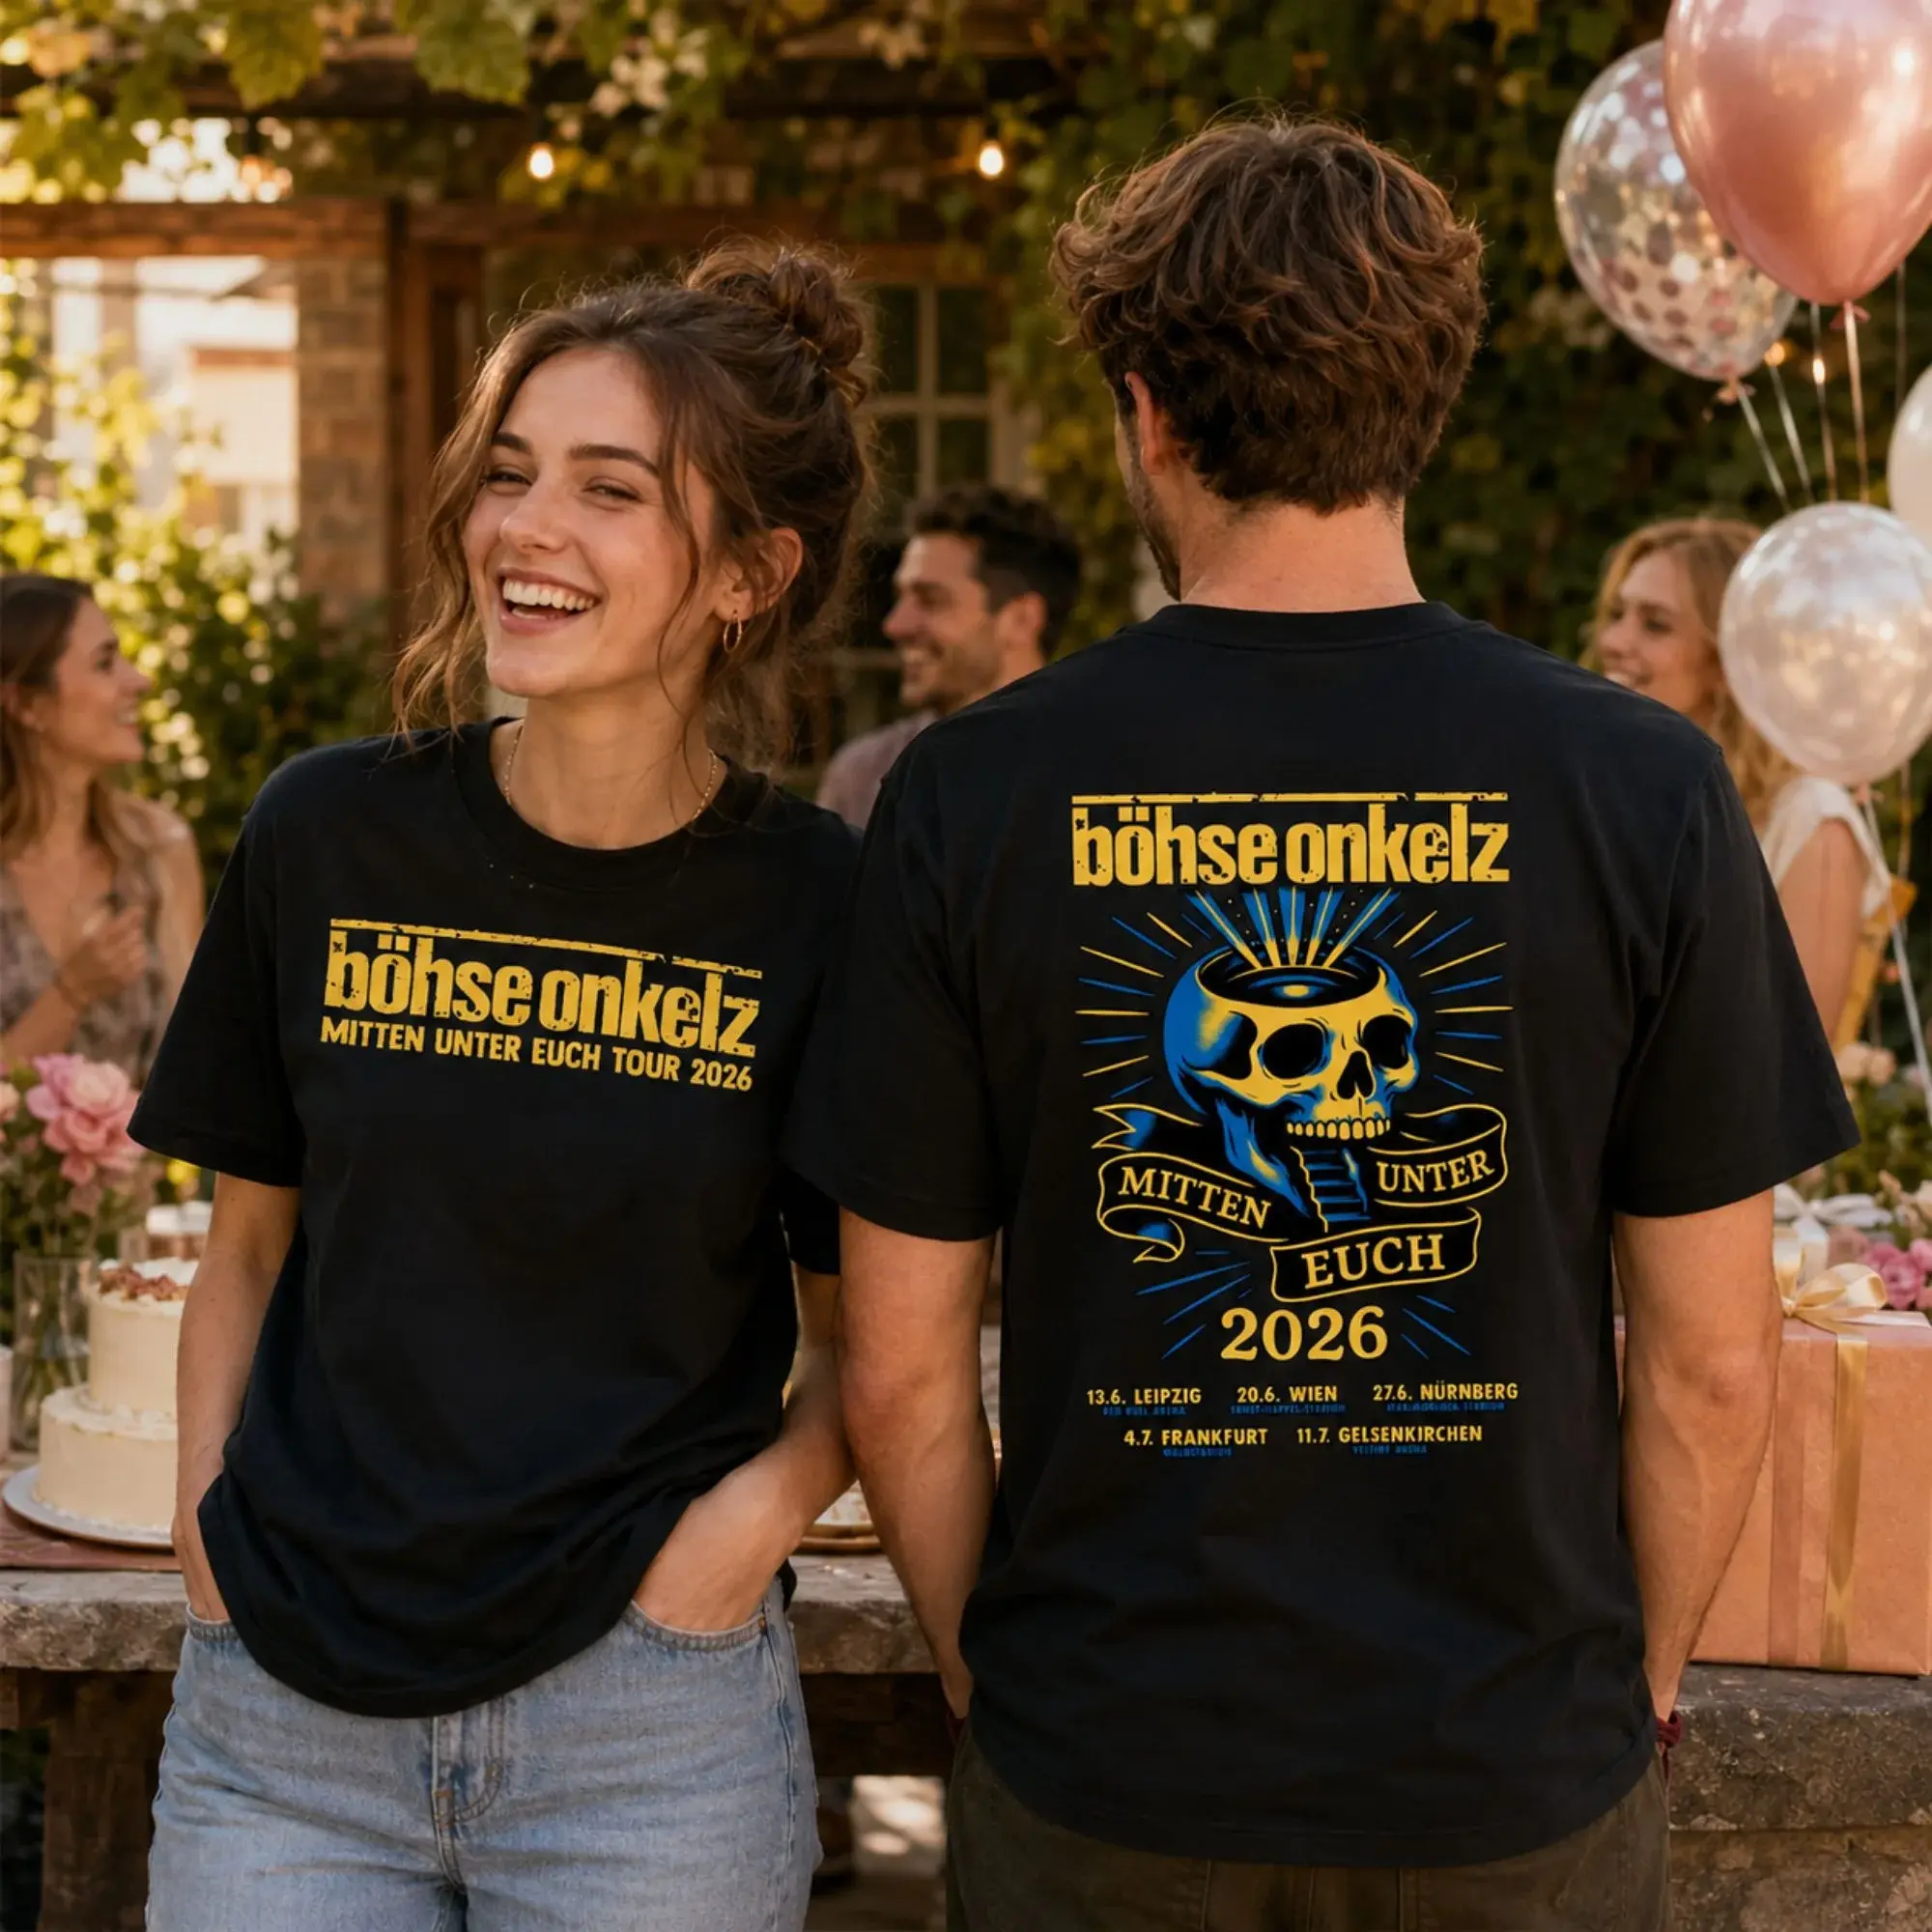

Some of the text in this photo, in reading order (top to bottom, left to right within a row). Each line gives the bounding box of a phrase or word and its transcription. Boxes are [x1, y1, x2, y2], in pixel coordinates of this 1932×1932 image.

[1072, 803, 1511, 887] böhse onkelz
[324, 929, 760, 1059] böhse onkelz
[320, 1016, 753, 1092] MITTEN UNTER EUCH TOUR 2026
[1117, 1148, 1496, 1229] MITTEN UNTER
[1301, 1234, 1446, 1290] EUCH
[1220, 1305, 1388, 1361] 2026
[1087, 1387, 1202, 1406] 13.6. LEIPZIG
[1236, 1385, 1338, 1404] 20.6. WIEN
[1373, 1380, 1519, 1401] 27.6. NÜRNBERG
[1123, 1428, 1268, 1446] 4.7. FRANKFURT
[1296, 1425, 1482, 1444] 11.7. GELSENKIRCHEN
